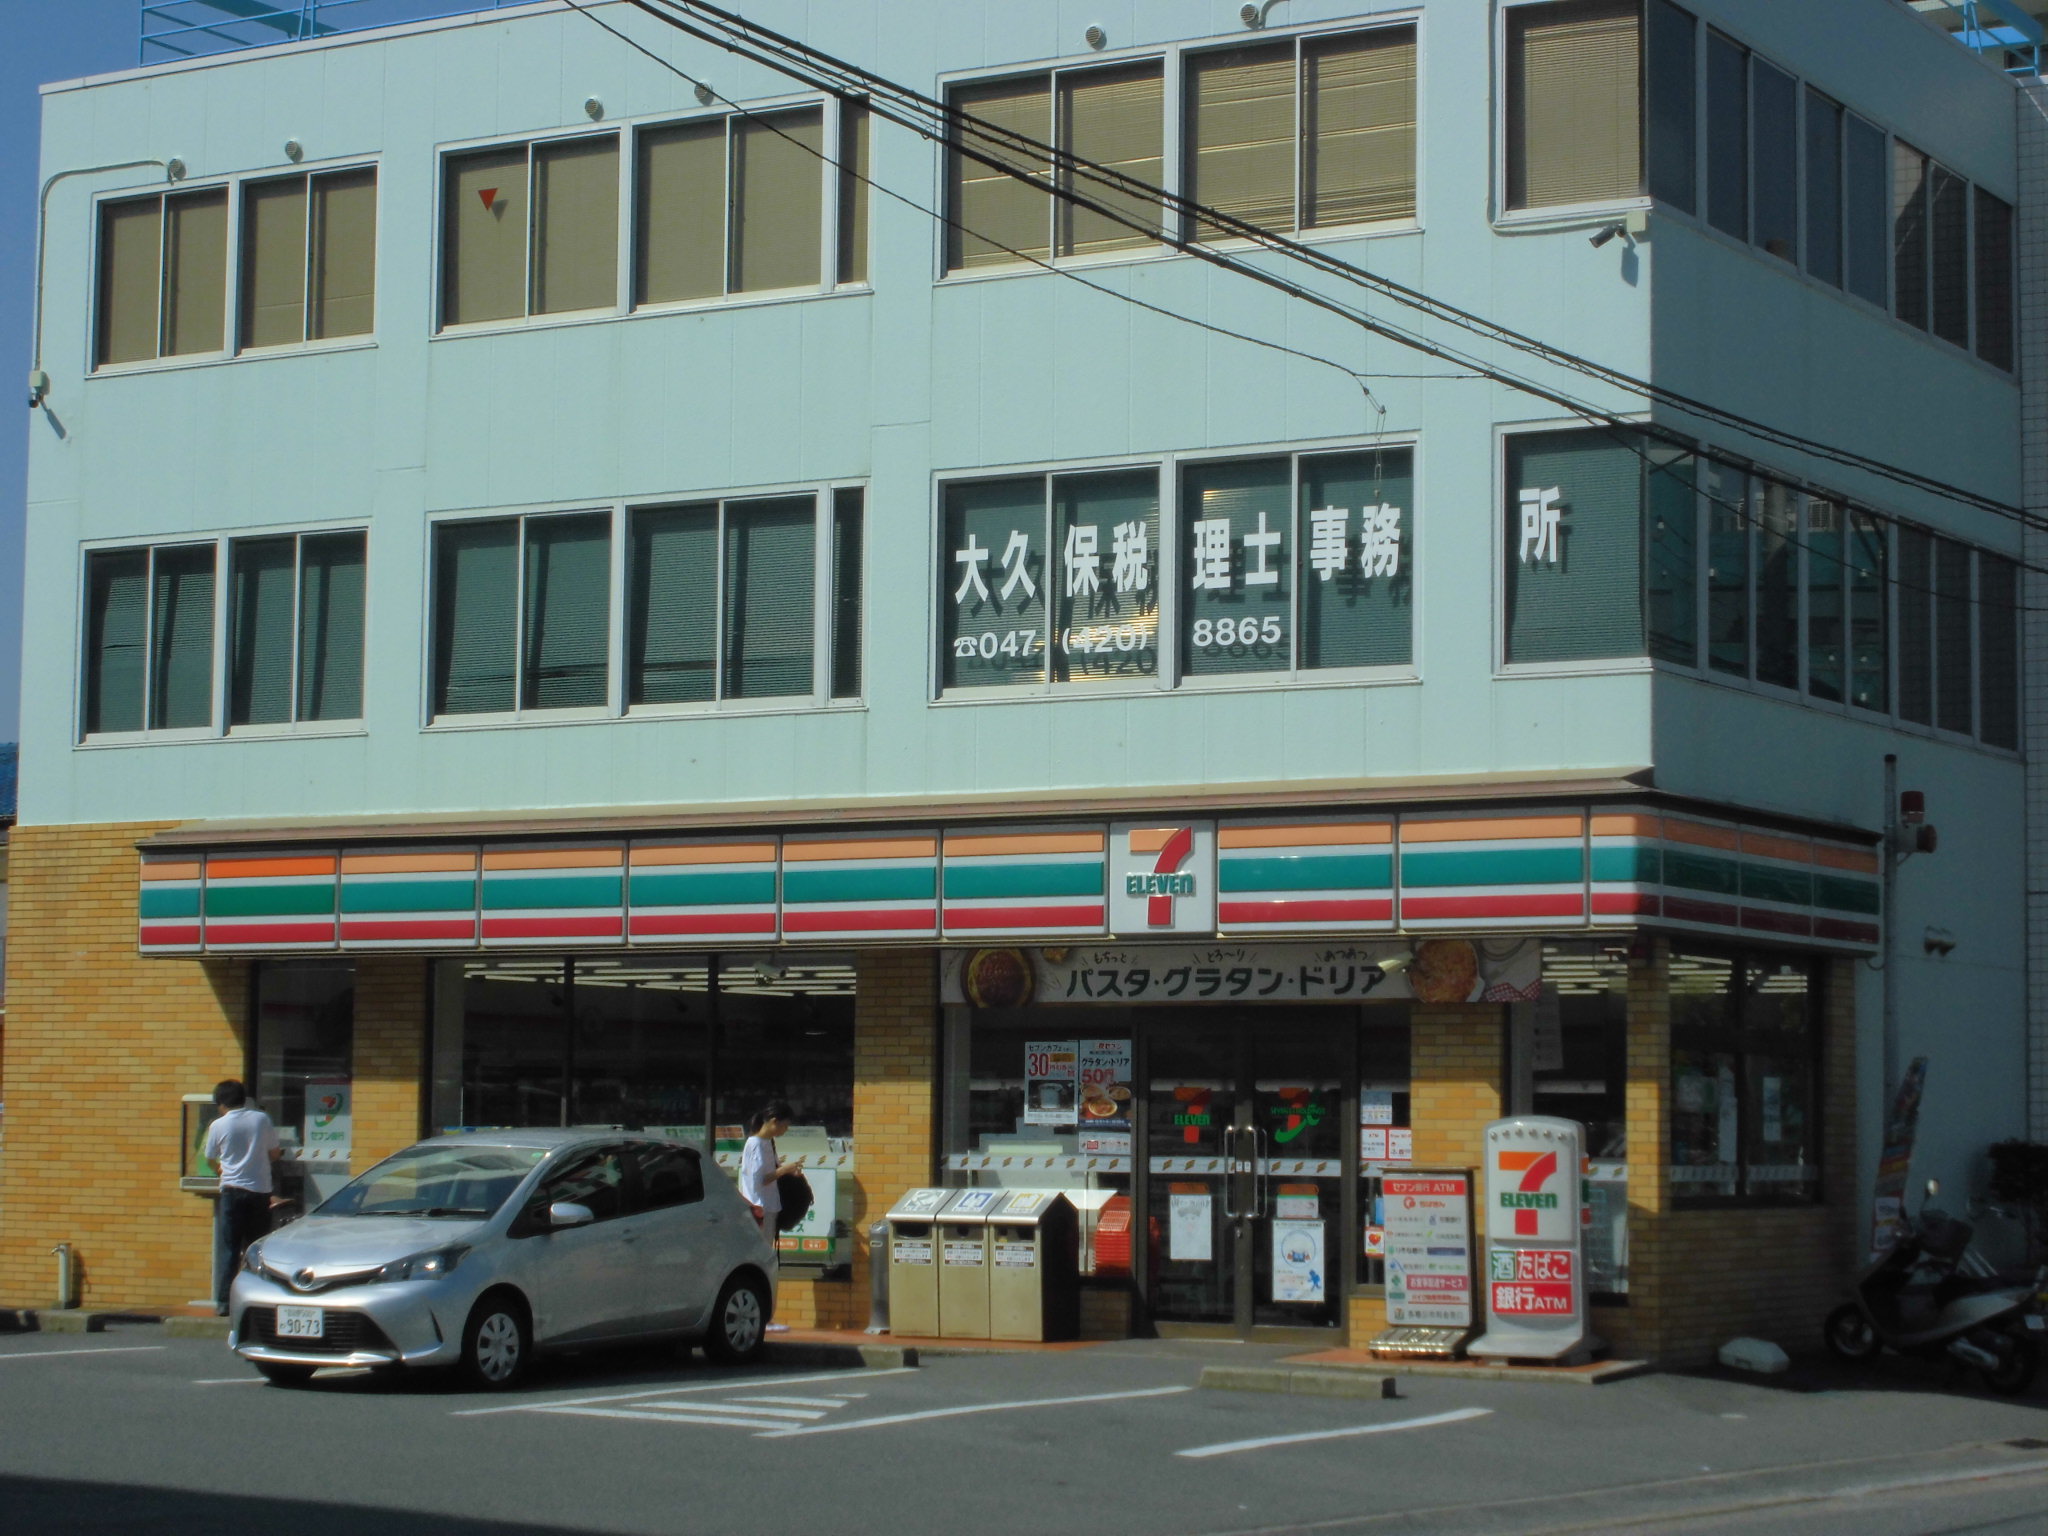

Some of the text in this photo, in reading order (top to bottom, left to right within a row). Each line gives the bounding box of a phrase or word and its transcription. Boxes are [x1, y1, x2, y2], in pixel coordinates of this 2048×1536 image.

[954, 486, 1561, 605] 大久保税理士事務所
[979, 615, 1281, 660] 047 (420) 8865
[1129, 826, 1192, 926] 7
[1066, 964, 1387, 997] パスタ・グラタン・ドリア
[1028, 1053, 1049, 1076] 30
[1433, 1183, 1456, 1192] ATM
[1499, 1151, 1557, 1235] 7
[1493, 1253, 1570, 1279] 酒 たばこ
